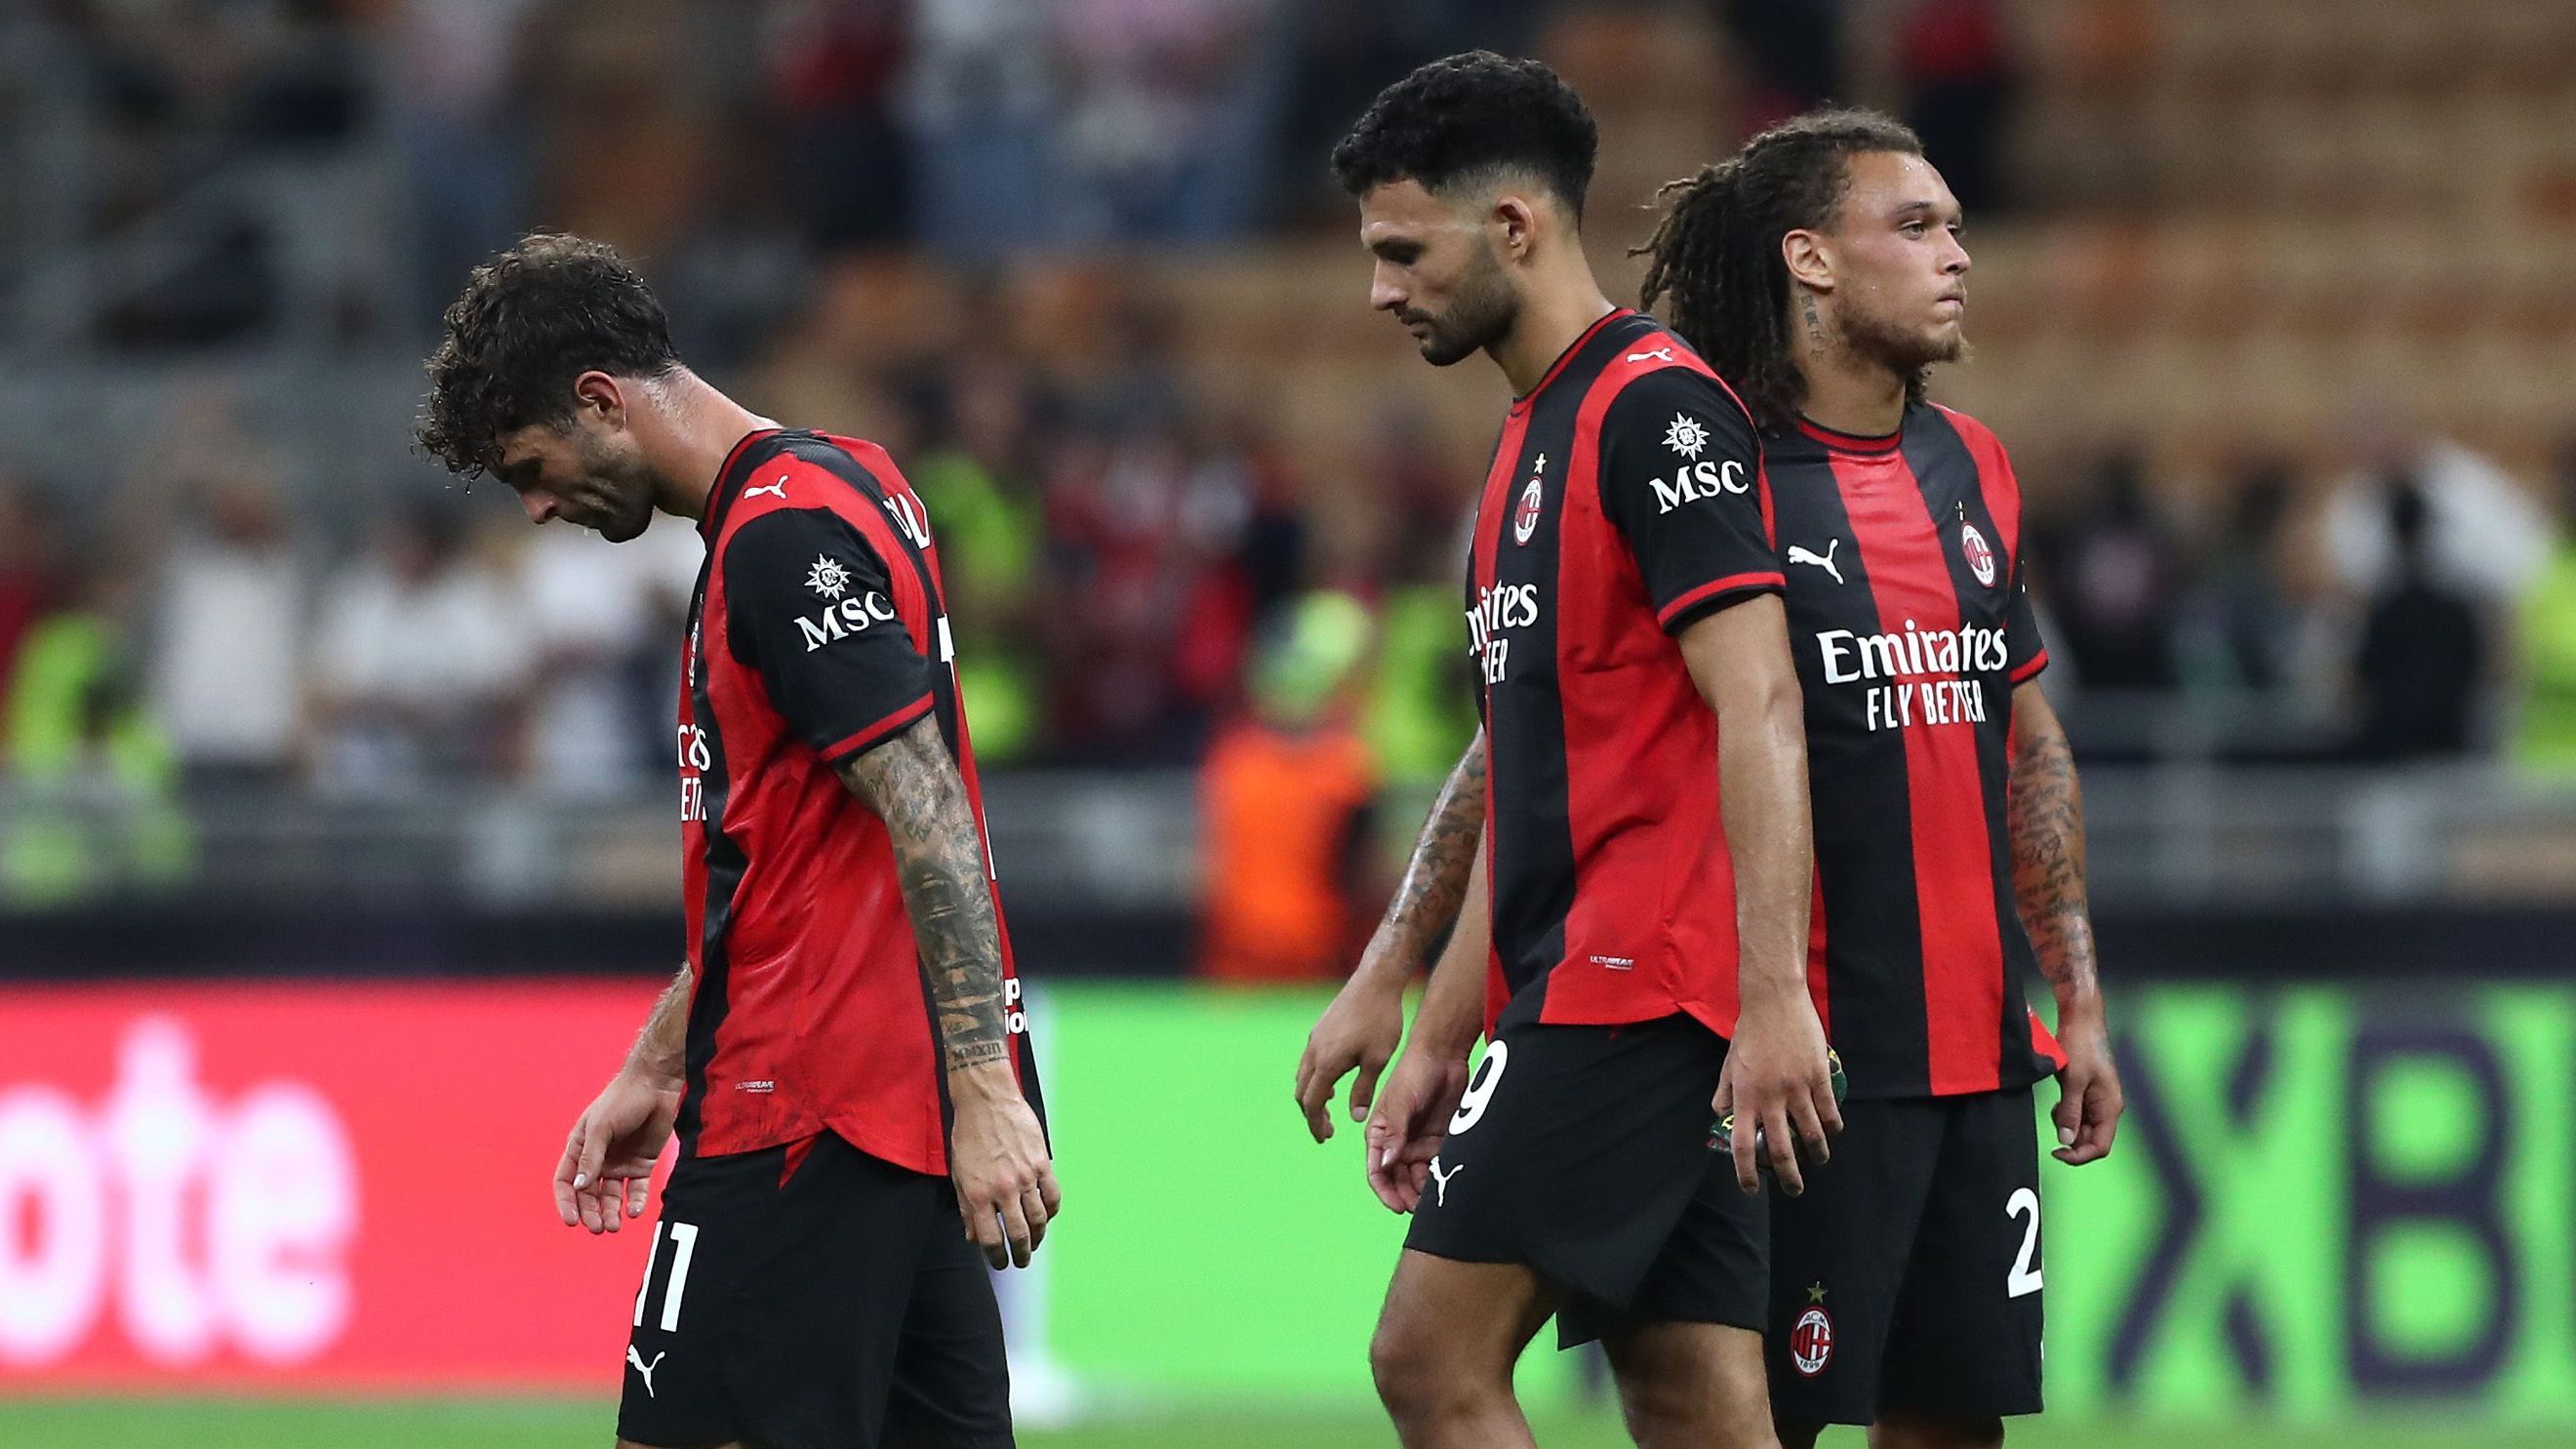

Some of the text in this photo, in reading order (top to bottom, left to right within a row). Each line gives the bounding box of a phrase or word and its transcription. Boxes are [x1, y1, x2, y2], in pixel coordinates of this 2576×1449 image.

[1649, 460, 1750, 514] MSC
[793, 590, 895, 652] MSC
[1816, 618, 2008, 684] Emirates
[1867, 679, 1987, 732] FLY BETTER
[1448, 1039, 1509, 1136] 9
